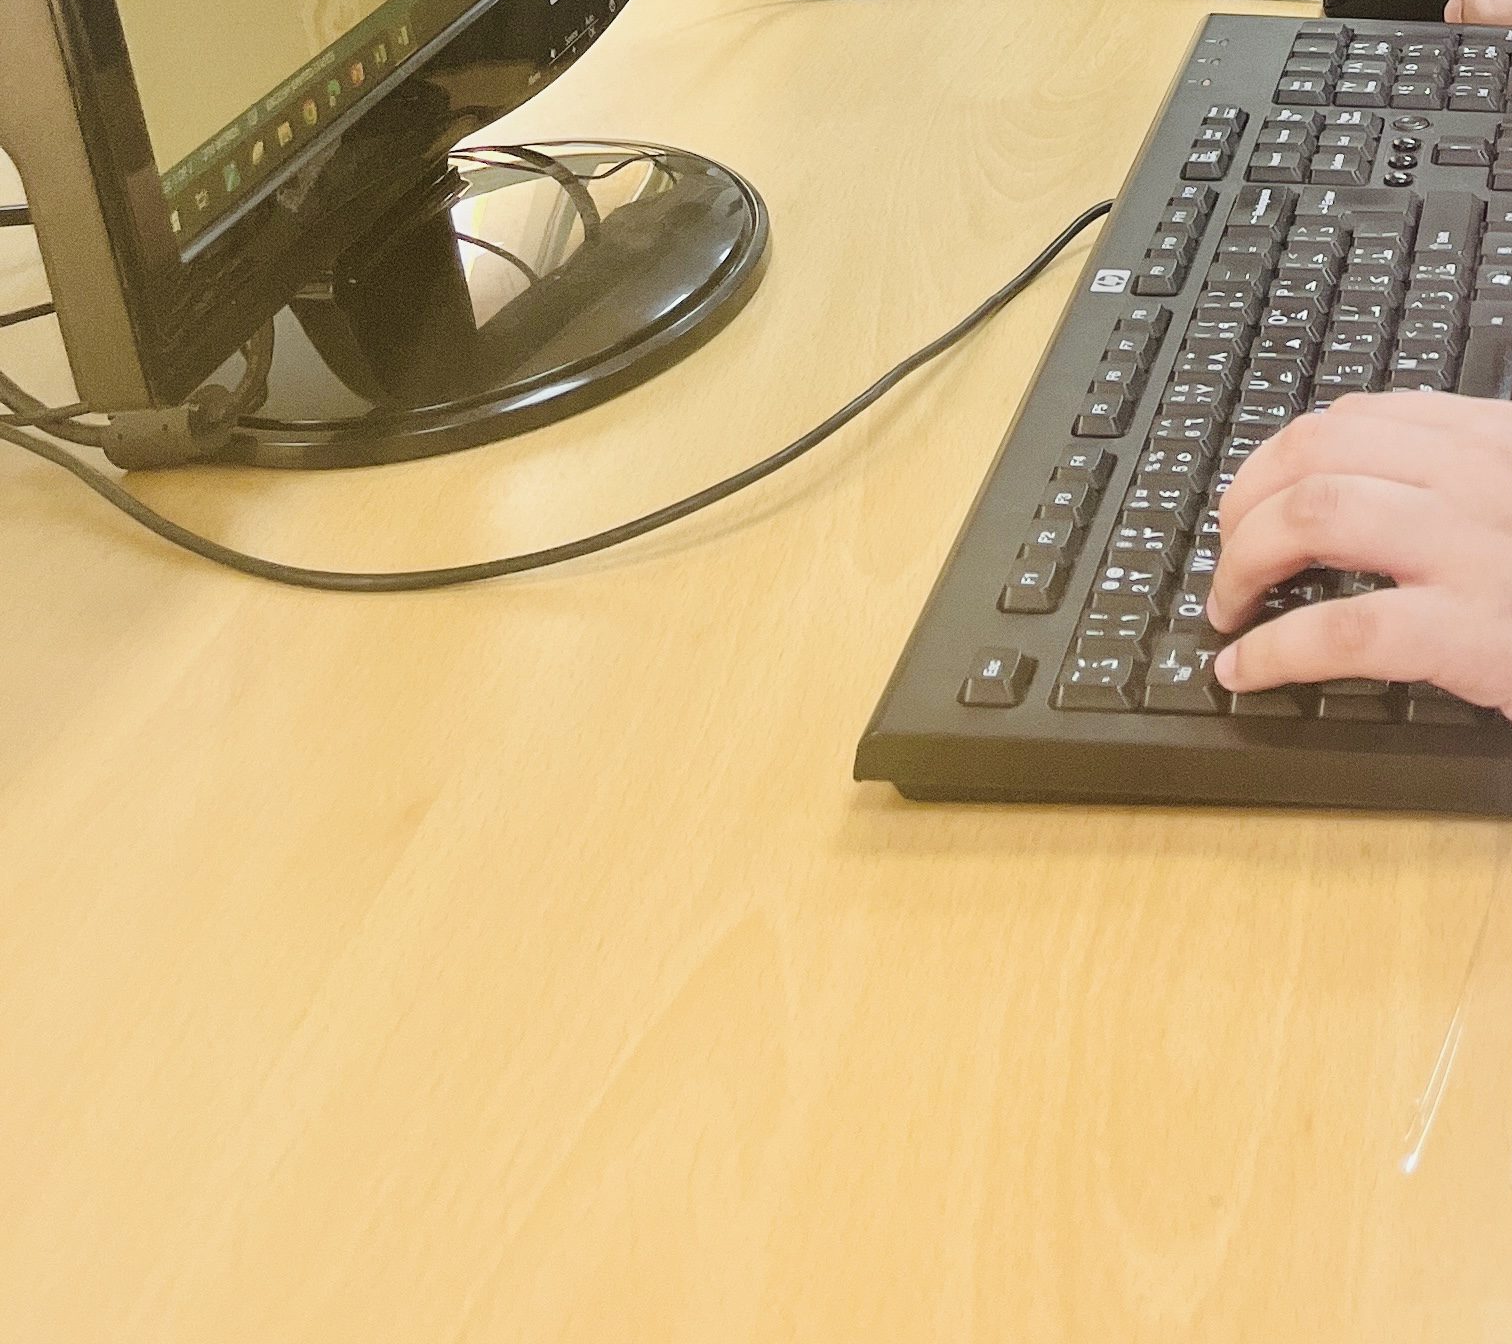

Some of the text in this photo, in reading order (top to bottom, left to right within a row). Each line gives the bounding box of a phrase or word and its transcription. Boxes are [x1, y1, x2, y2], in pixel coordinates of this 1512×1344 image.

[1070, 456, 1086, 466] F4
[1055, 493, 1071, 504] F3
[1038, 532, 1055, 543] F2
[1021, 574, 1038, 584] F1
[983, 661, 1000, 676] Esc
